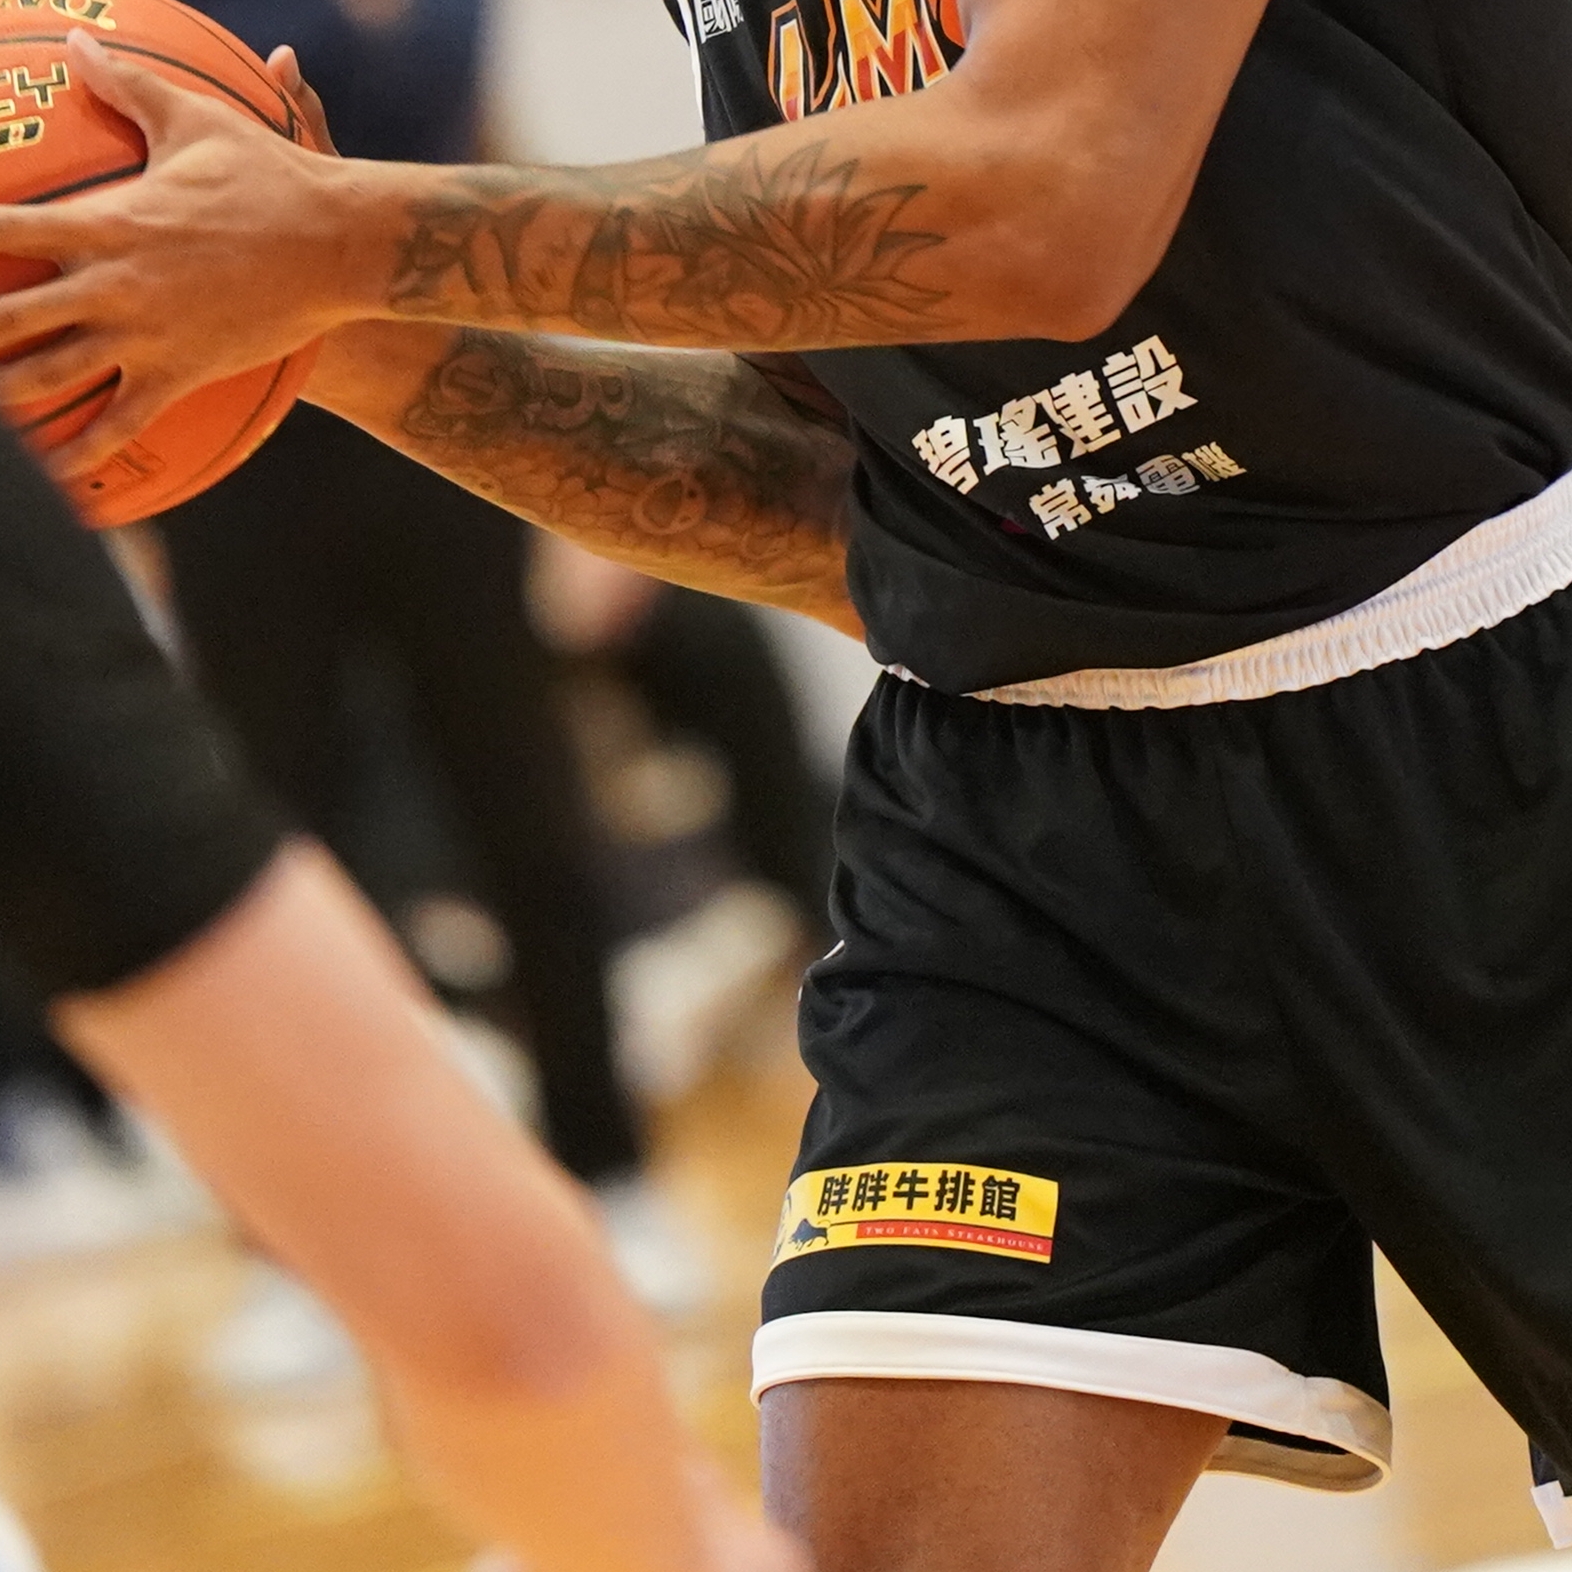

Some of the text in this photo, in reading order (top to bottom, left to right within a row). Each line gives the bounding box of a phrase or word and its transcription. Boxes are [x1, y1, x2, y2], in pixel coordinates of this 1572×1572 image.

[817, 1168, 1021, 1222] 胖胖牛排館
[864, 1226, 896, 1236] TWO
[946, 1228, 1045, 1253] STEAKHOUSE
